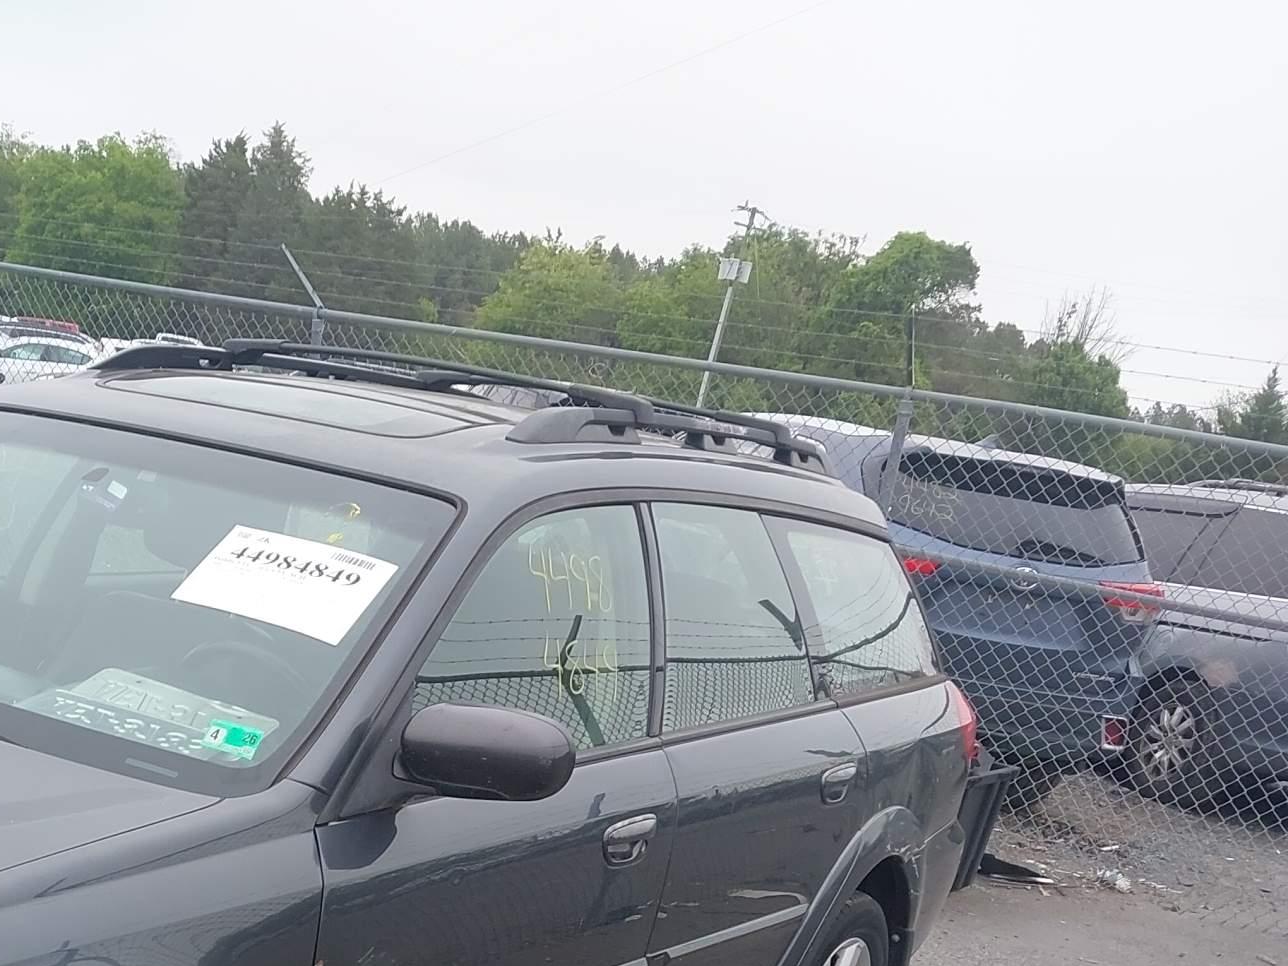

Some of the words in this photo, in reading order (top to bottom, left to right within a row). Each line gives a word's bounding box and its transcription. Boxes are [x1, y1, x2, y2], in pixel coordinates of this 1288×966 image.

[230, 546, 362, 587] 44984849
[528, 543, 613, 615] 4498
[544, 631, 619, 702] 4849
[210, 728, 221, 741] 4
[242, 731, 259, 746] 26
